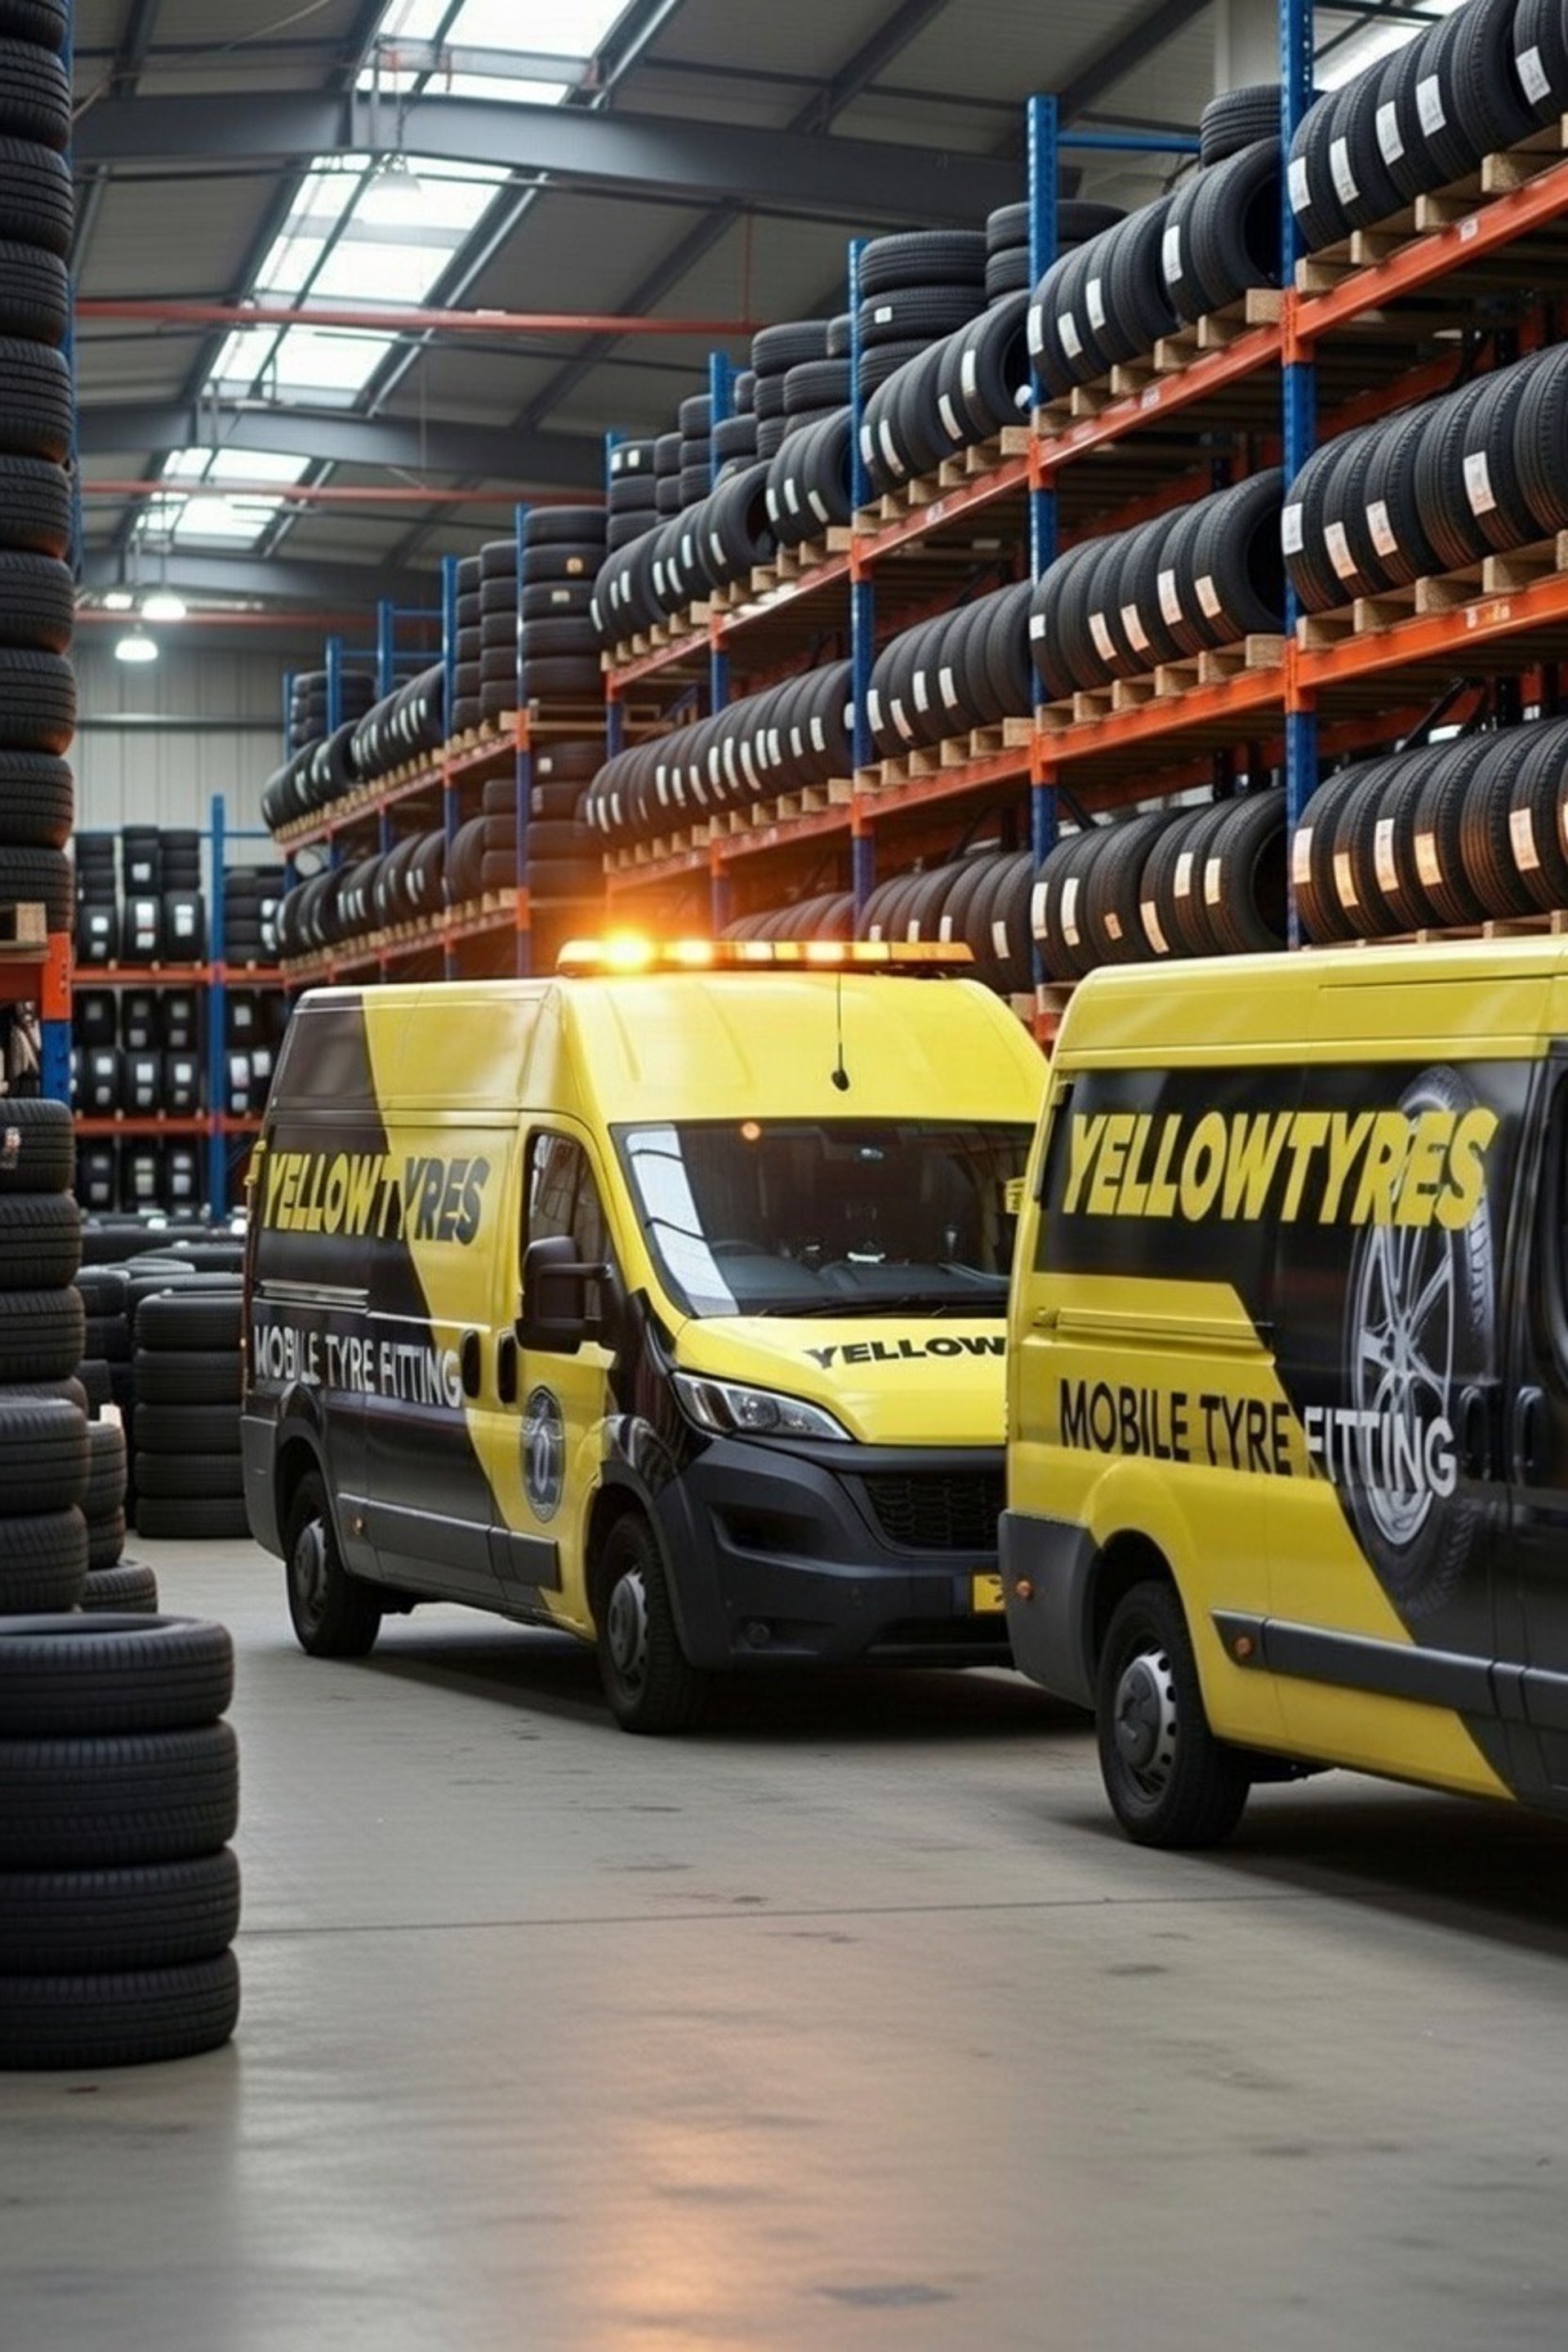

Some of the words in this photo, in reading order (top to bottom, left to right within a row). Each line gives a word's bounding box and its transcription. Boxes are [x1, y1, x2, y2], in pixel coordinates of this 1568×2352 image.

[263, 1152, 490, 1246] YELLOWTYRES
[1062, 1107, 1499, 1231] YELLOWTYRES
[325, 1334, 376, 1393] TYRE
[381, 1341, 462, 1408] FITTING
[1061, 1379, 1190, 1462] MOBILE
[1200, 1395, 1292, 1477] TYRE
[1305, 1405, 1458, 1498] FITTING
